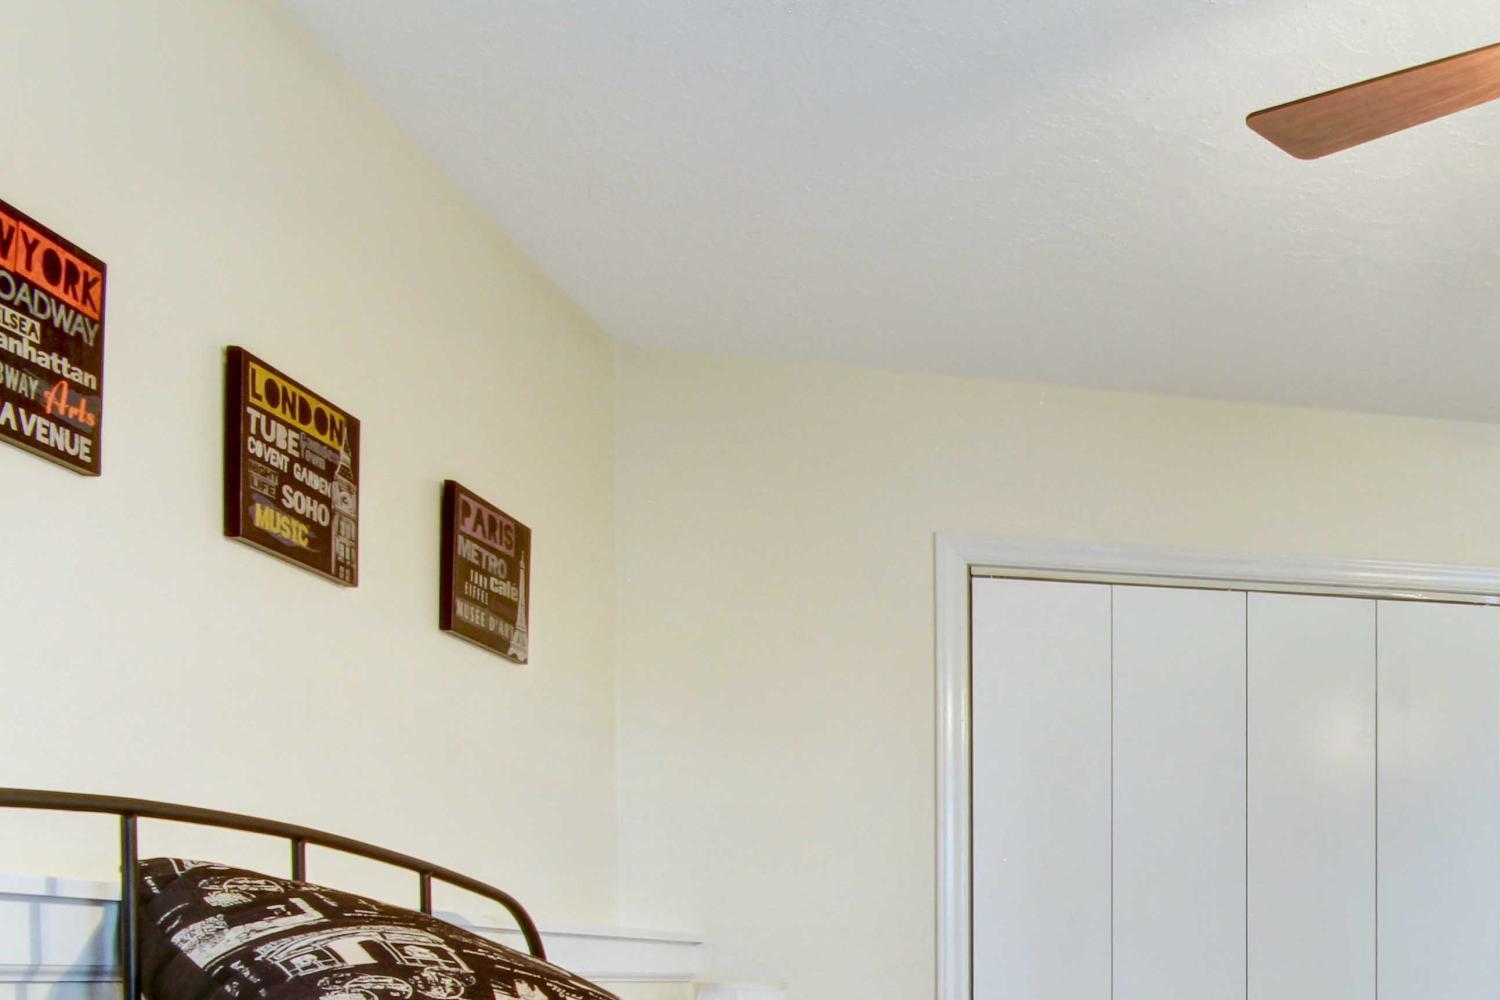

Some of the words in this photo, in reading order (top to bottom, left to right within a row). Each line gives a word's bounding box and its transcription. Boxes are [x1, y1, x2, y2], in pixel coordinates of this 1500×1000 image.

[20, 228, 101, 315] YORK
[0, 270, 99, 347] OADWAY
[0, 312, 39, 340] LSEA
[0, 335, 97, 391] anhattan
[0, 363, 39, 400] BWAY
[43, 380, 96, 428] Arts
[251, 366, 344, 448] LONDON
[0, 401, 93, 463] AVENUE
[247, 406, 300, 458] TUBE
[247, 436, 290, 473] COVENT
[293, 462, 332, 498] GARDEN
[255, 502, 310, 548] MUSIC
[281, 484, 330, 527] SOHO
[460, 499, 515, 551] PARIS
[457, 534, 508, 580] METRO
